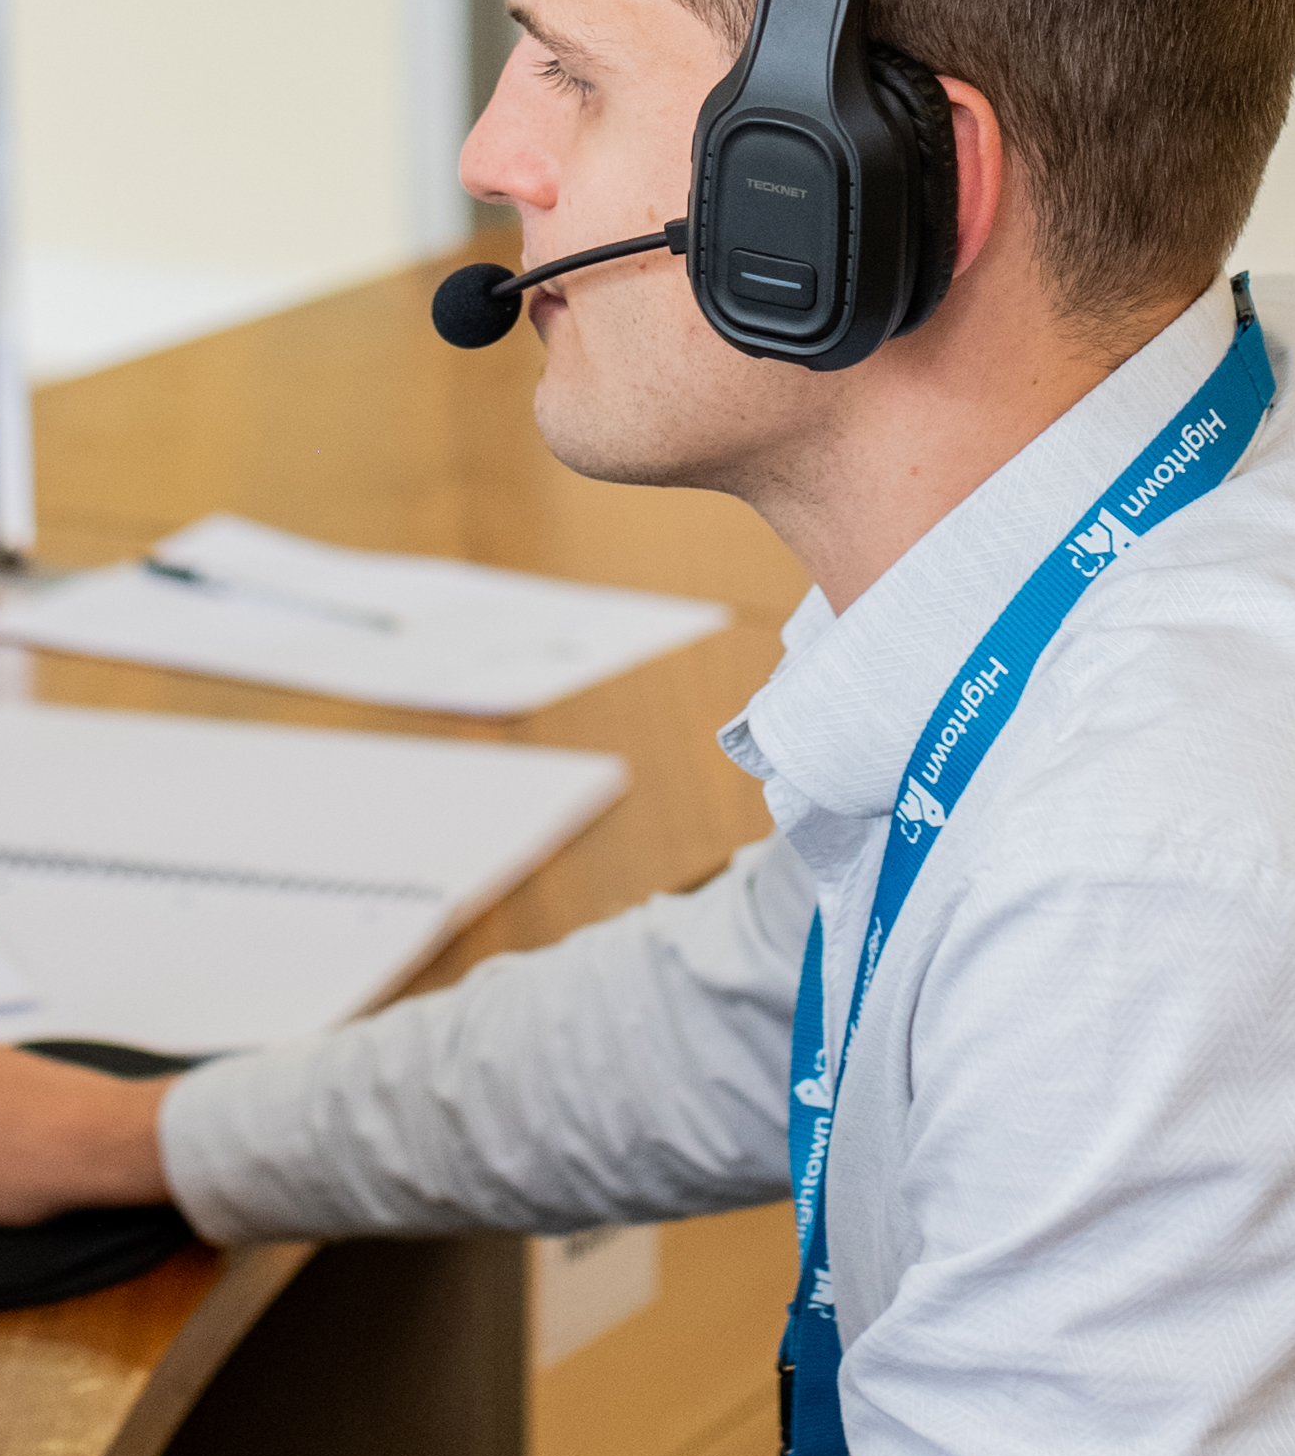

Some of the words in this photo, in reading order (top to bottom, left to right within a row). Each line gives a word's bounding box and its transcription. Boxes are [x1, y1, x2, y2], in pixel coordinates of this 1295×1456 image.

[745, 177, 808, 199] TECKNET
[1120, 408, 1227, 518] Hightown
[921, 655, 1009, 785] Hightown
